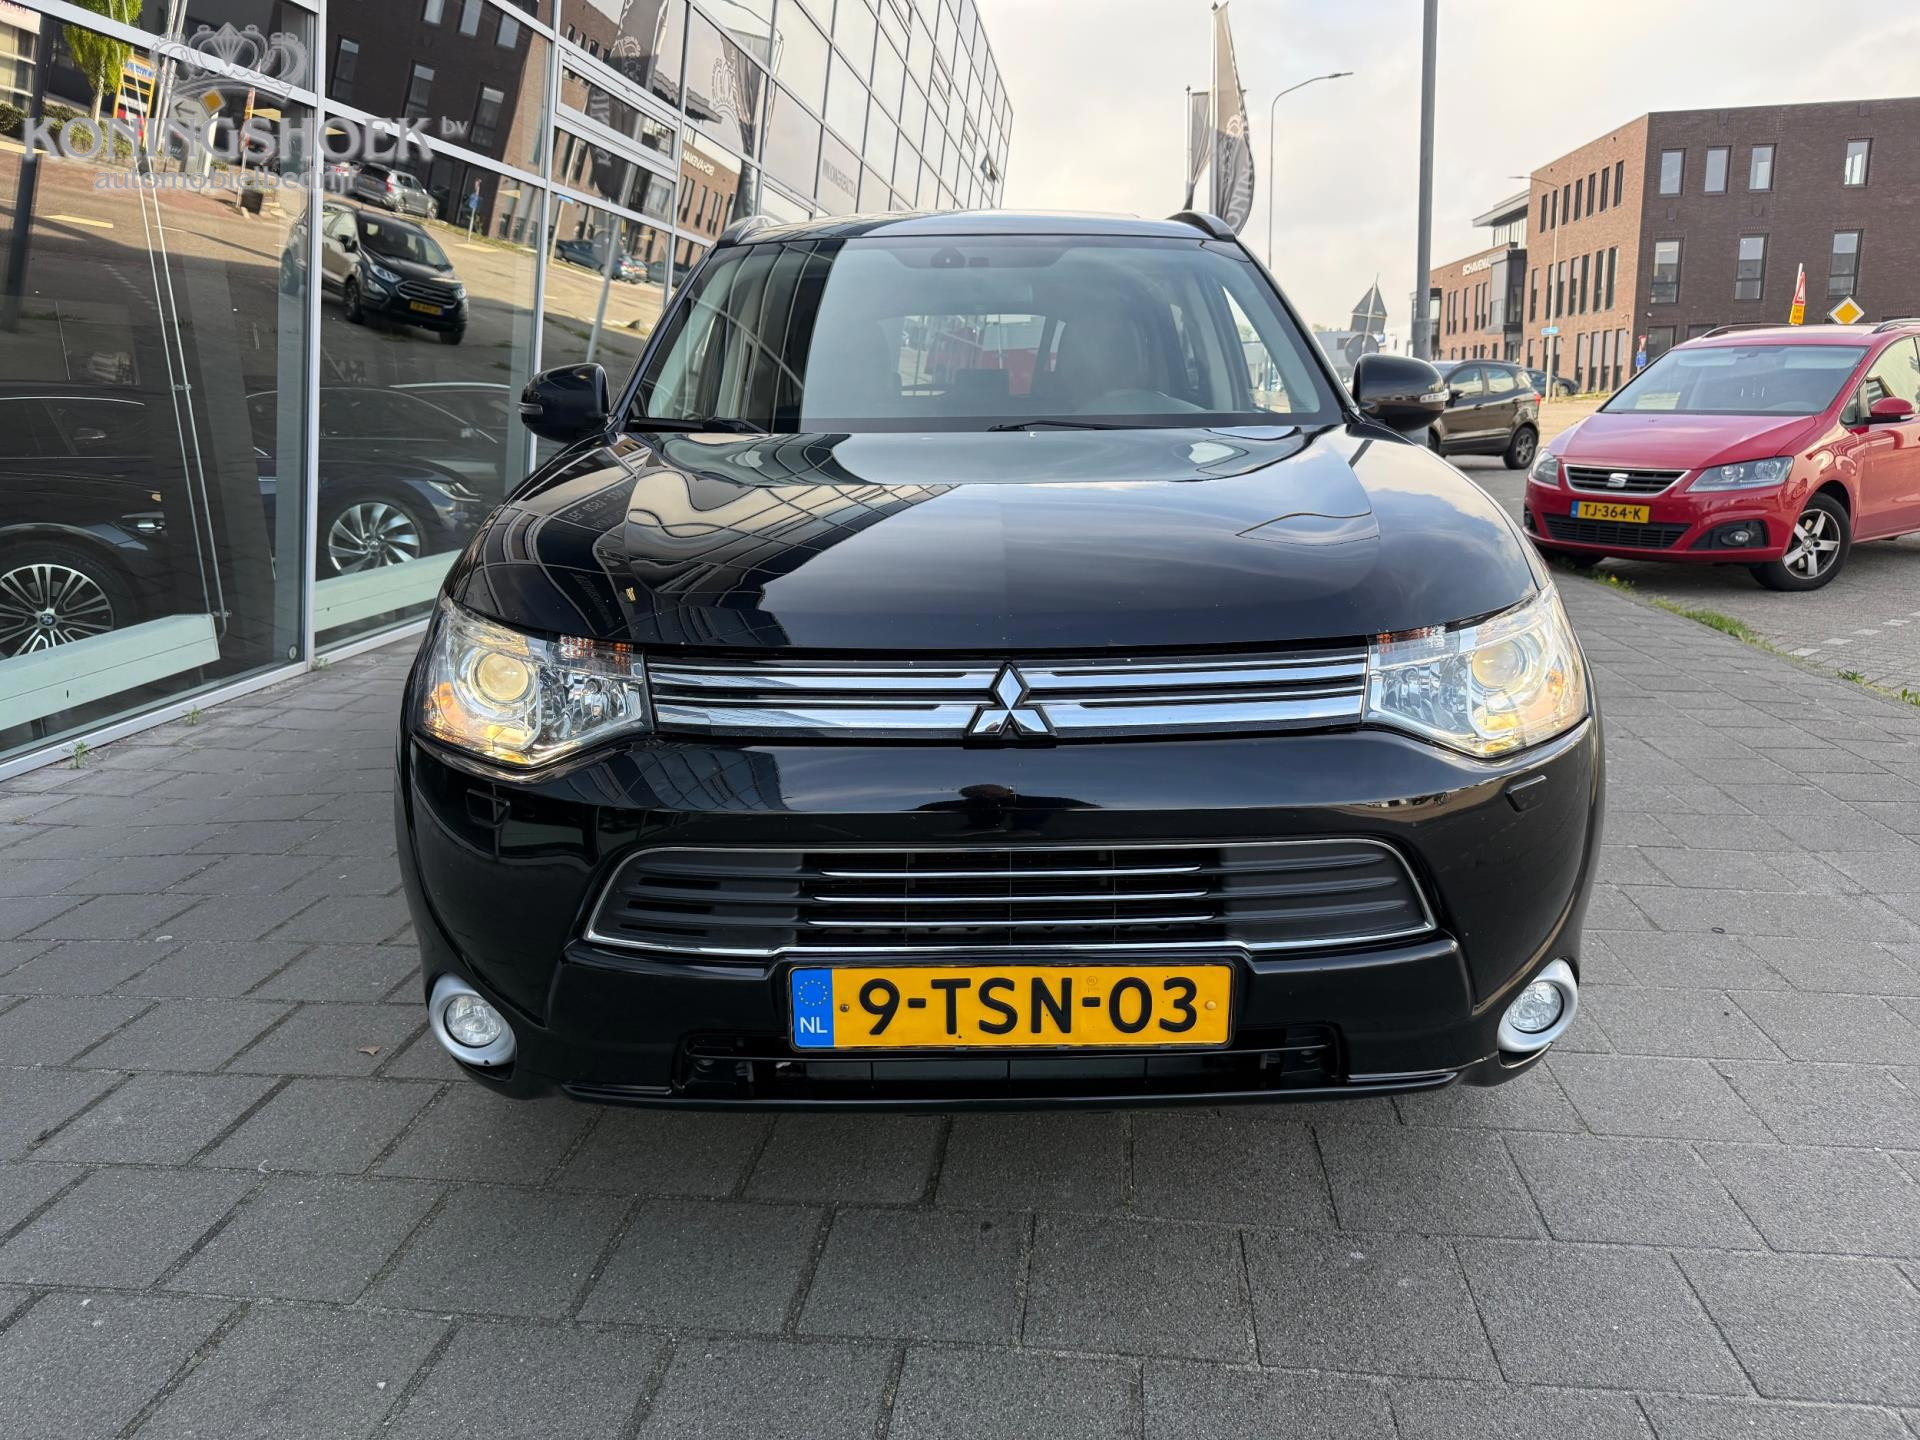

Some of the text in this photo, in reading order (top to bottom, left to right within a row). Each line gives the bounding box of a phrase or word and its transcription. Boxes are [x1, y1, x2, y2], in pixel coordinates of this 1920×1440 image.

[1583, 503, 1641, 521] TJ-364-K
[799, 1017, 828, 1034] NL
[858, 976, 1198, 1036] 9-TSN-03
